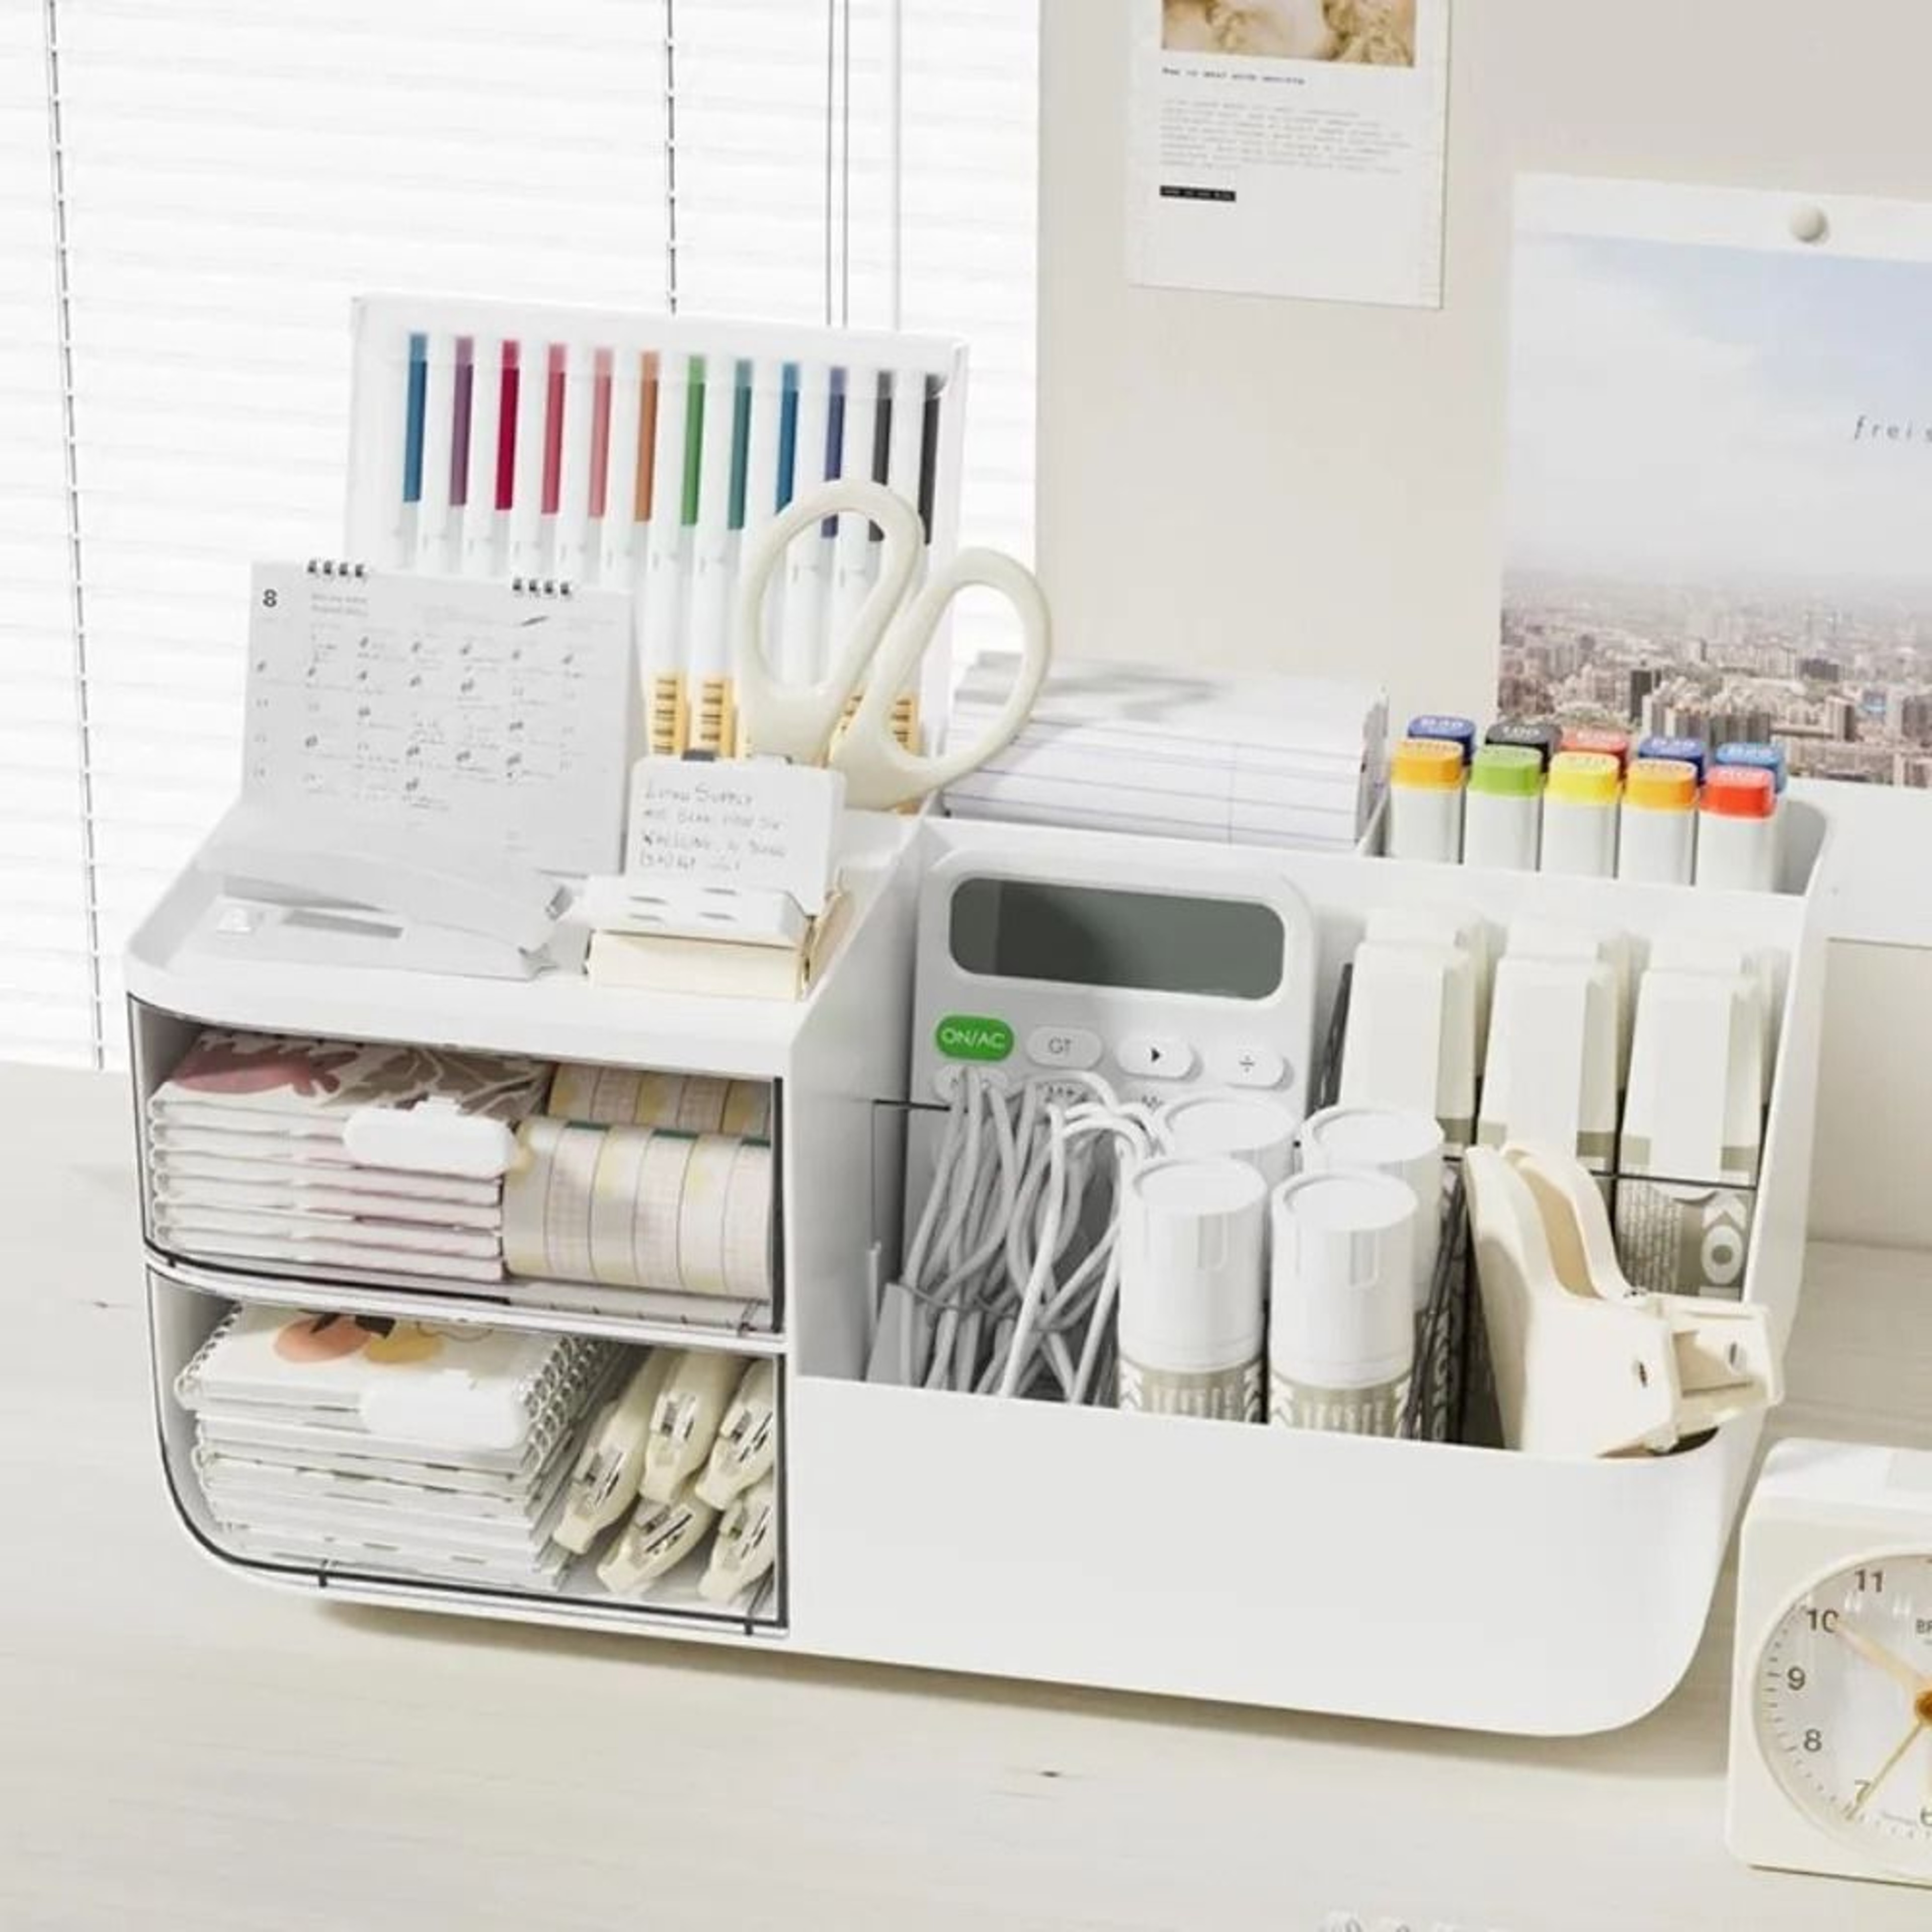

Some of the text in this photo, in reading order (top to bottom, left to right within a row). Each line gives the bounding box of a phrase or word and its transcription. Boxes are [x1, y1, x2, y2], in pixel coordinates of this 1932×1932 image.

[262, 589, 277, 608] 8
[941, 1027, 1006, 1049] ON/AC
[1049, 1037, 1073, 1054] GT
[1854, 1569, 1884, 1593] 11
[1807, 1608, 1839, 1634] 10
[1787, 1666, 1806, 1692] 9
[1804, 1728, 1823, 1753] 8
[1854, 1779, 1871, 1804] 7
